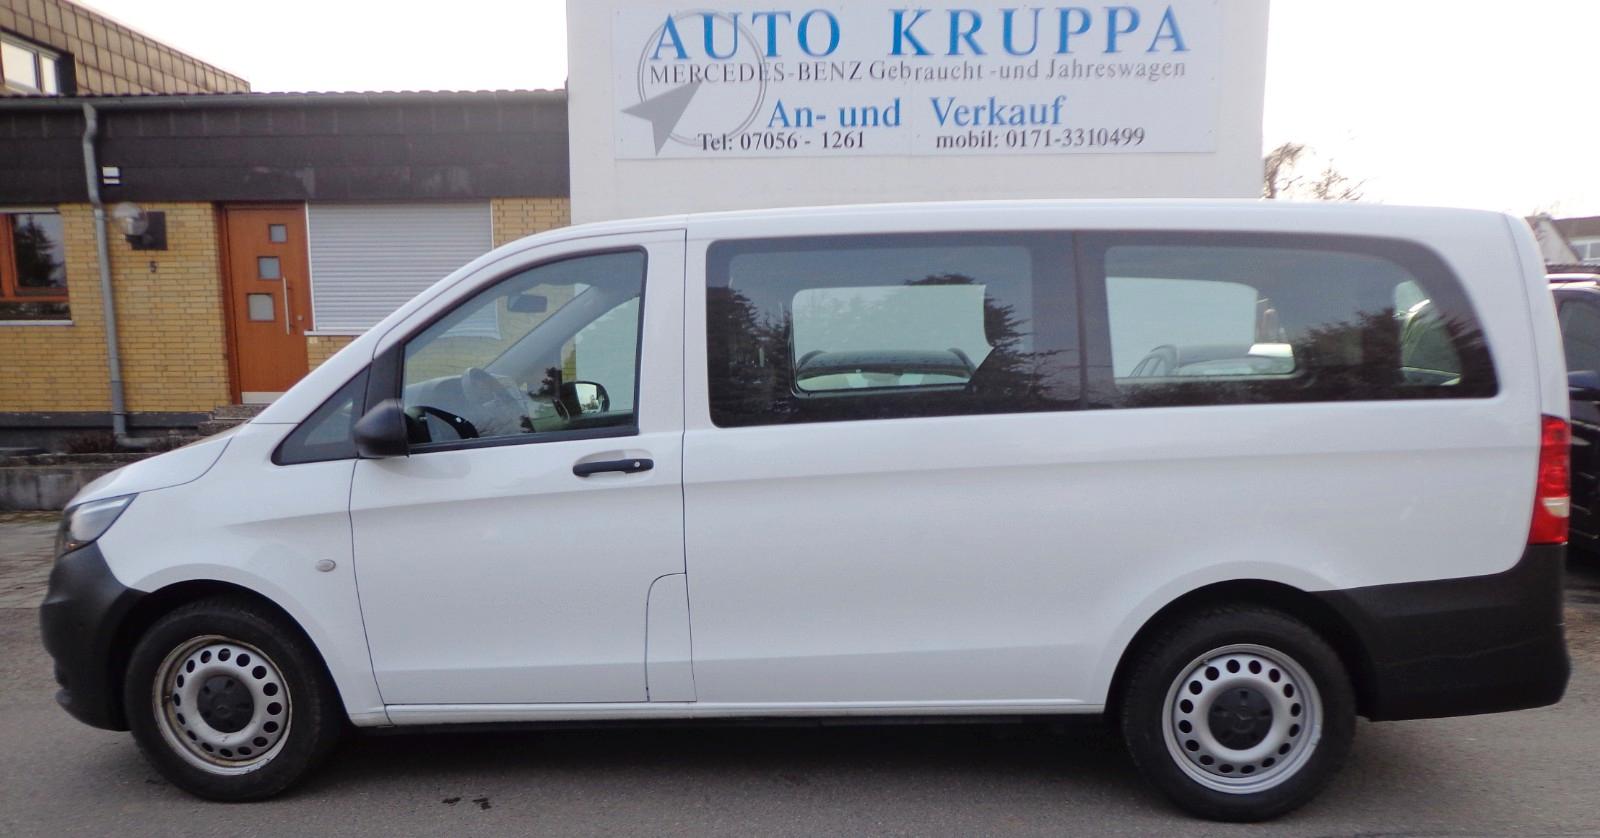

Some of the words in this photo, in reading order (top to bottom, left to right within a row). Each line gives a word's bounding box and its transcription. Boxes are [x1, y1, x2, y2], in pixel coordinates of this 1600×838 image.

[650, 9, 841, 60] AUTO
[888, 5, 1191, 57] KRUPPA
[650, 61, 863, 84] MERCEDES-BENZ
[869, 60, 983, 84] Gebraucht
[1046, 58, 1186, 82] Jahreswagen
[767, 98, 826, 128] An-
[839, 97, 902, 127] und
[929, 95, 1067, 127] Verkauf
[697, 132, 733, 151] Tel:
[740, 131, 798, 150] 07056
[822, 131, 865, 149] 1261
[936, 130, 999, 149] mobil:
[1005, 127, 1145, 148] 0171-3310499
